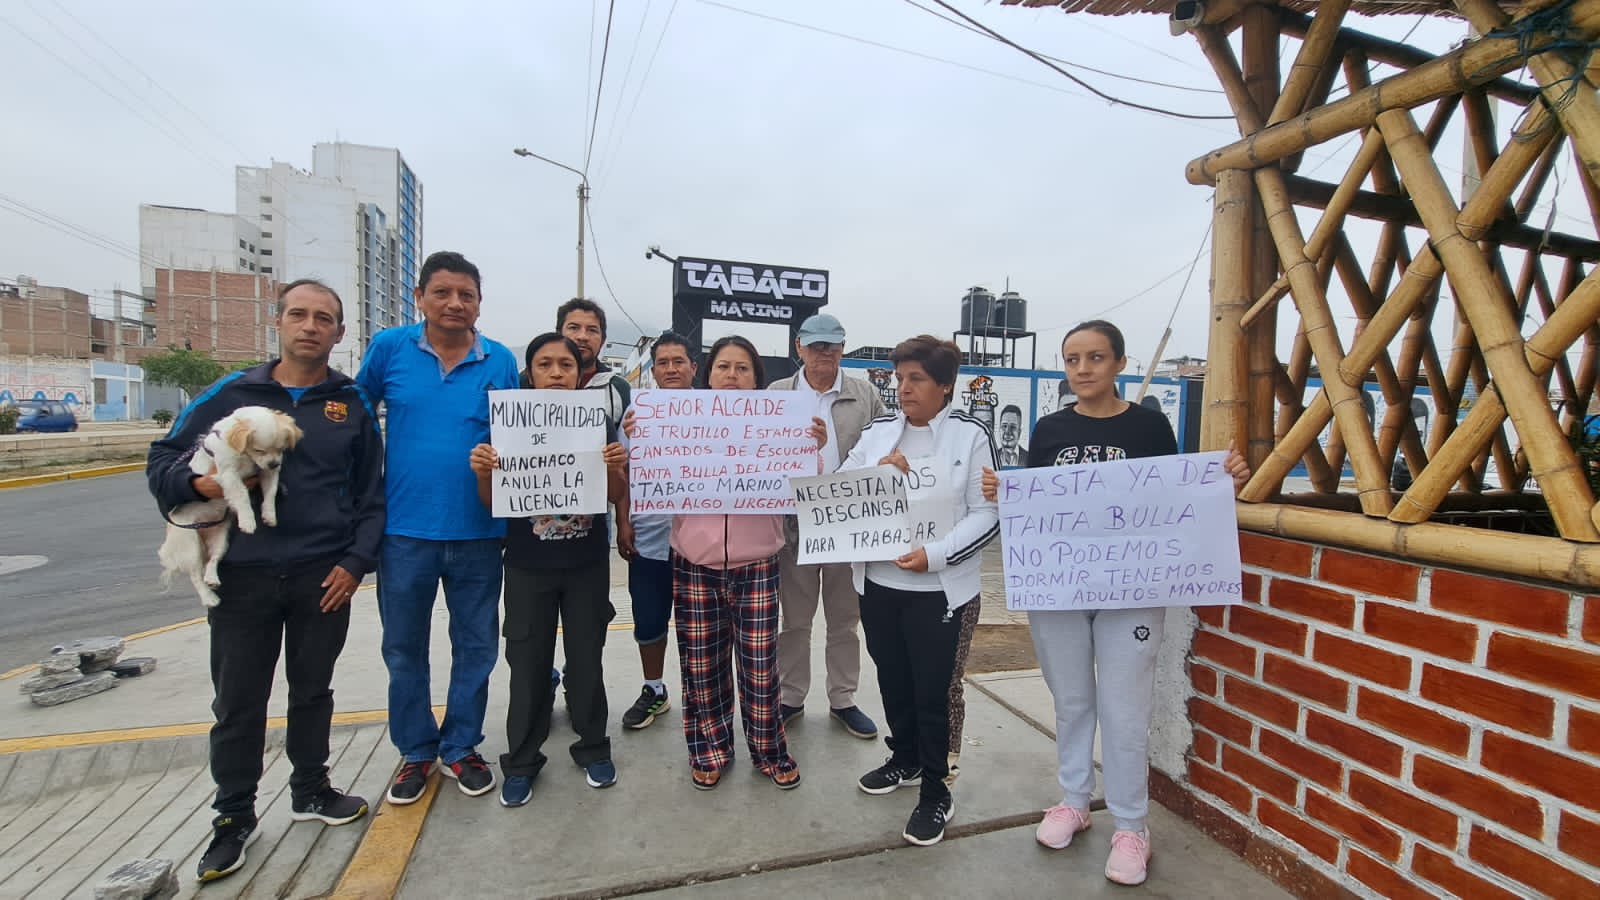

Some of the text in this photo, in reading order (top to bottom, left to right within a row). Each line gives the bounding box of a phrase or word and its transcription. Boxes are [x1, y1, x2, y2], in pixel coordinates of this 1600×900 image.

[682, 261, 827, 299] TABACO
[710, 300, 793, 319] MARINO
[491, 401, 606, 428] MUNICIPALIDAD
[635, 392, 785, 419] SEÑOR ALCALDE
[531, 433, 548, 445] DE
[632, 425, 650, 440] DE
[658, 425, 730, 440] TRUJILLO
[629, 445, 713, 461] CANSADOS
[725, 445, 748, 458] DE
[500, 471, 584, 490] ANULA LA
[631, 461, 804, 482] TANTA BULLA DEL LOCAL
[1001, 459, 1220, 505] BASTA YA DE
[509, 492, 579, 513] LICENCIA
[634, 496, 796, 513] HAGA ALGO URGENT
[1005, 503, 1196, 537] TANTA BULLA
[806, 521, 936, 554] PARA TRABAJAR
[1009, 539, 1182, 568] NO PODEMOS
[1104, 563, 1214, 585] TENEMOS
[1071, 585, 1160, 606] ADULTOS
[1169, 580, 1241, 597] MAYORES
